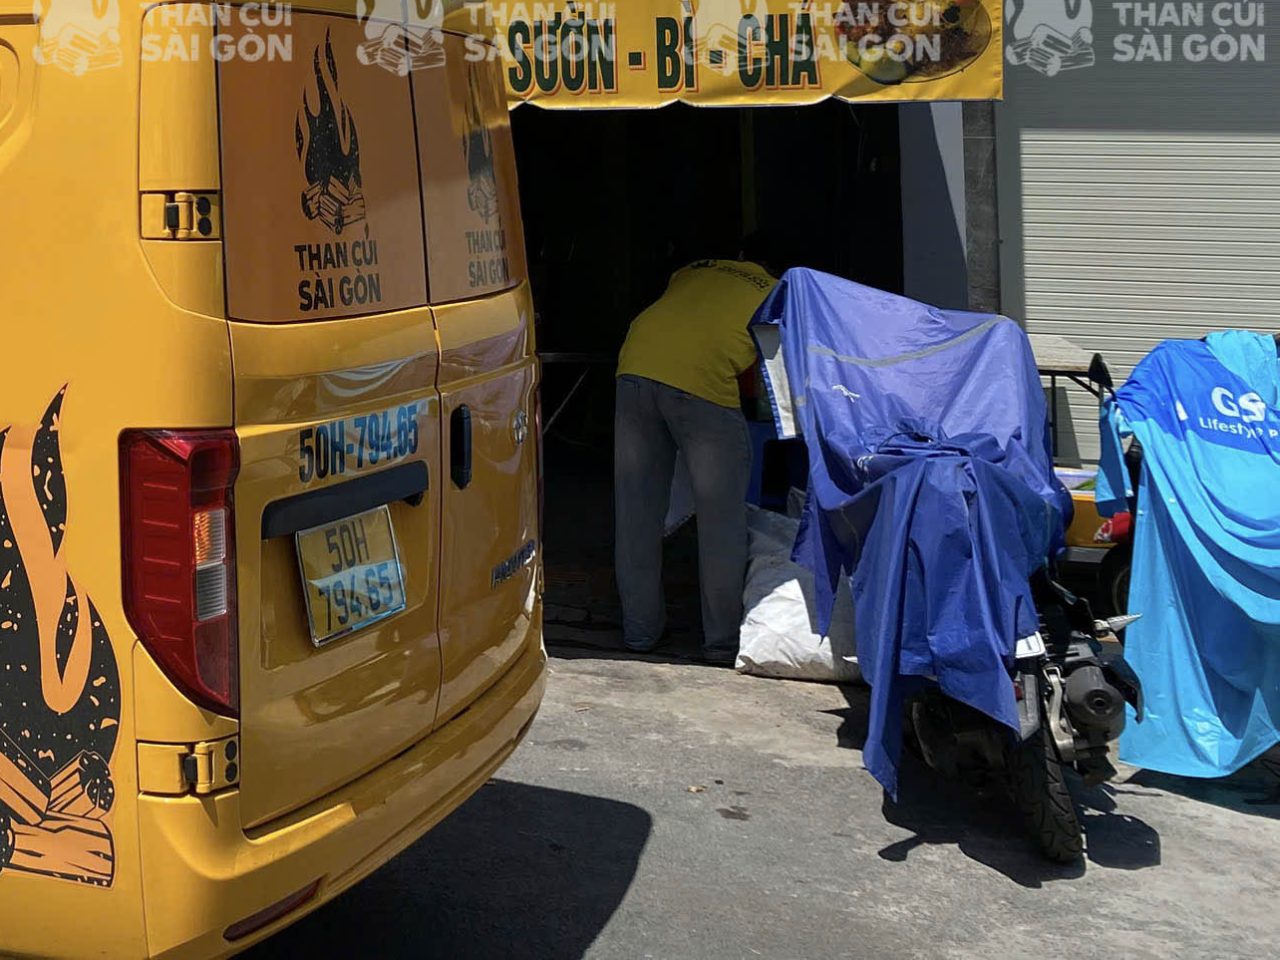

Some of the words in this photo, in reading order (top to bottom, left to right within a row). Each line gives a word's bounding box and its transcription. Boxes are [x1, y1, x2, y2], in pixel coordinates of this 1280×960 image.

[294, 241, 348, 272] THAN
[298, 271, 335, 312] SÀI
[339, 268, 382, 306] GÒN
[299, 404, 419, 484] 50H-794.65
[324, 518, 371, 572] 50H
[317, 562, 395, 632] 794.65
